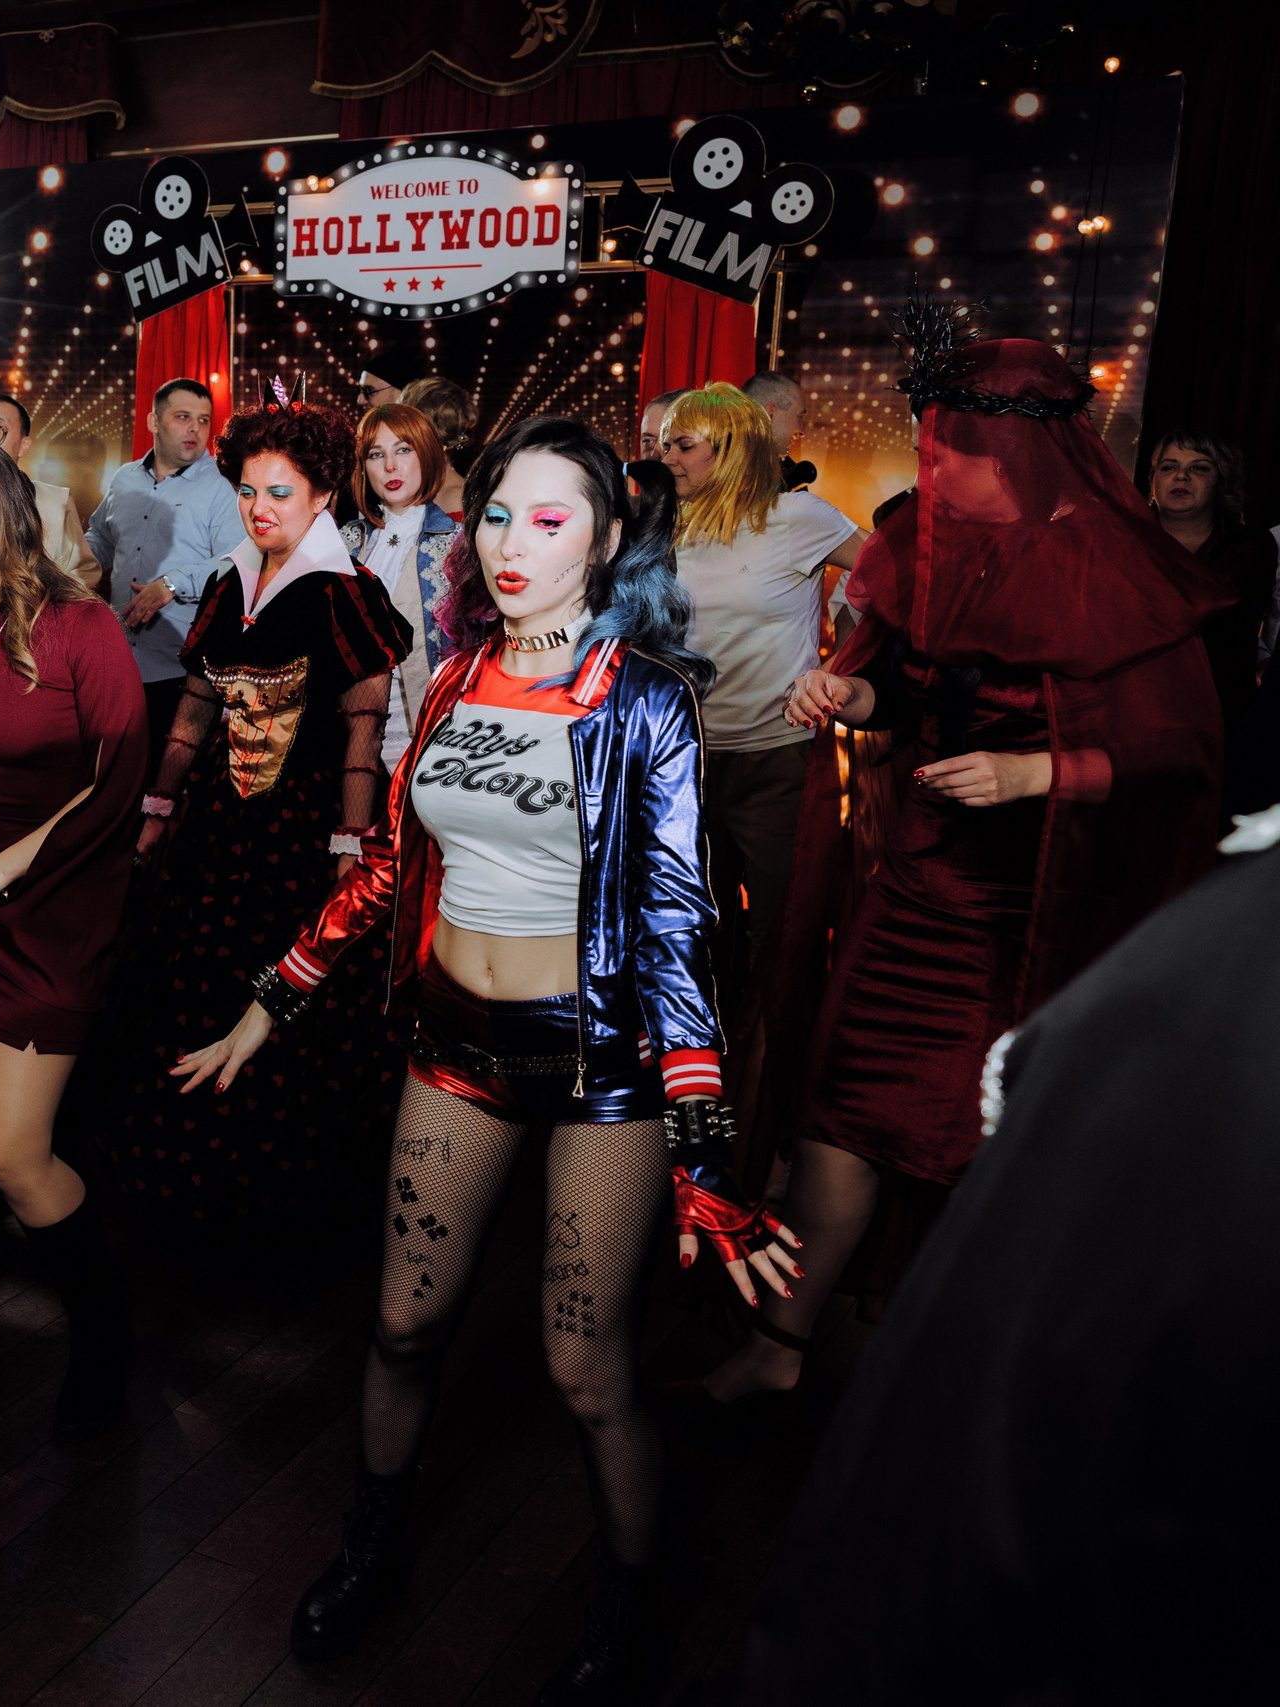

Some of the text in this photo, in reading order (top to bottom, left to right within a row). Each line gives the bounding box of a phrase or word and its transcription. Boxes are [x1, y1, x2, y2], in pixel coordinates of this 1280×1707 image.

[370, 178, 479, 200] WELCOME TO
[292, 204, 561, 257] HOLLYWOOD
[644, 208, 772, 290] FILM
[124, 232, 224, 308] FILM
